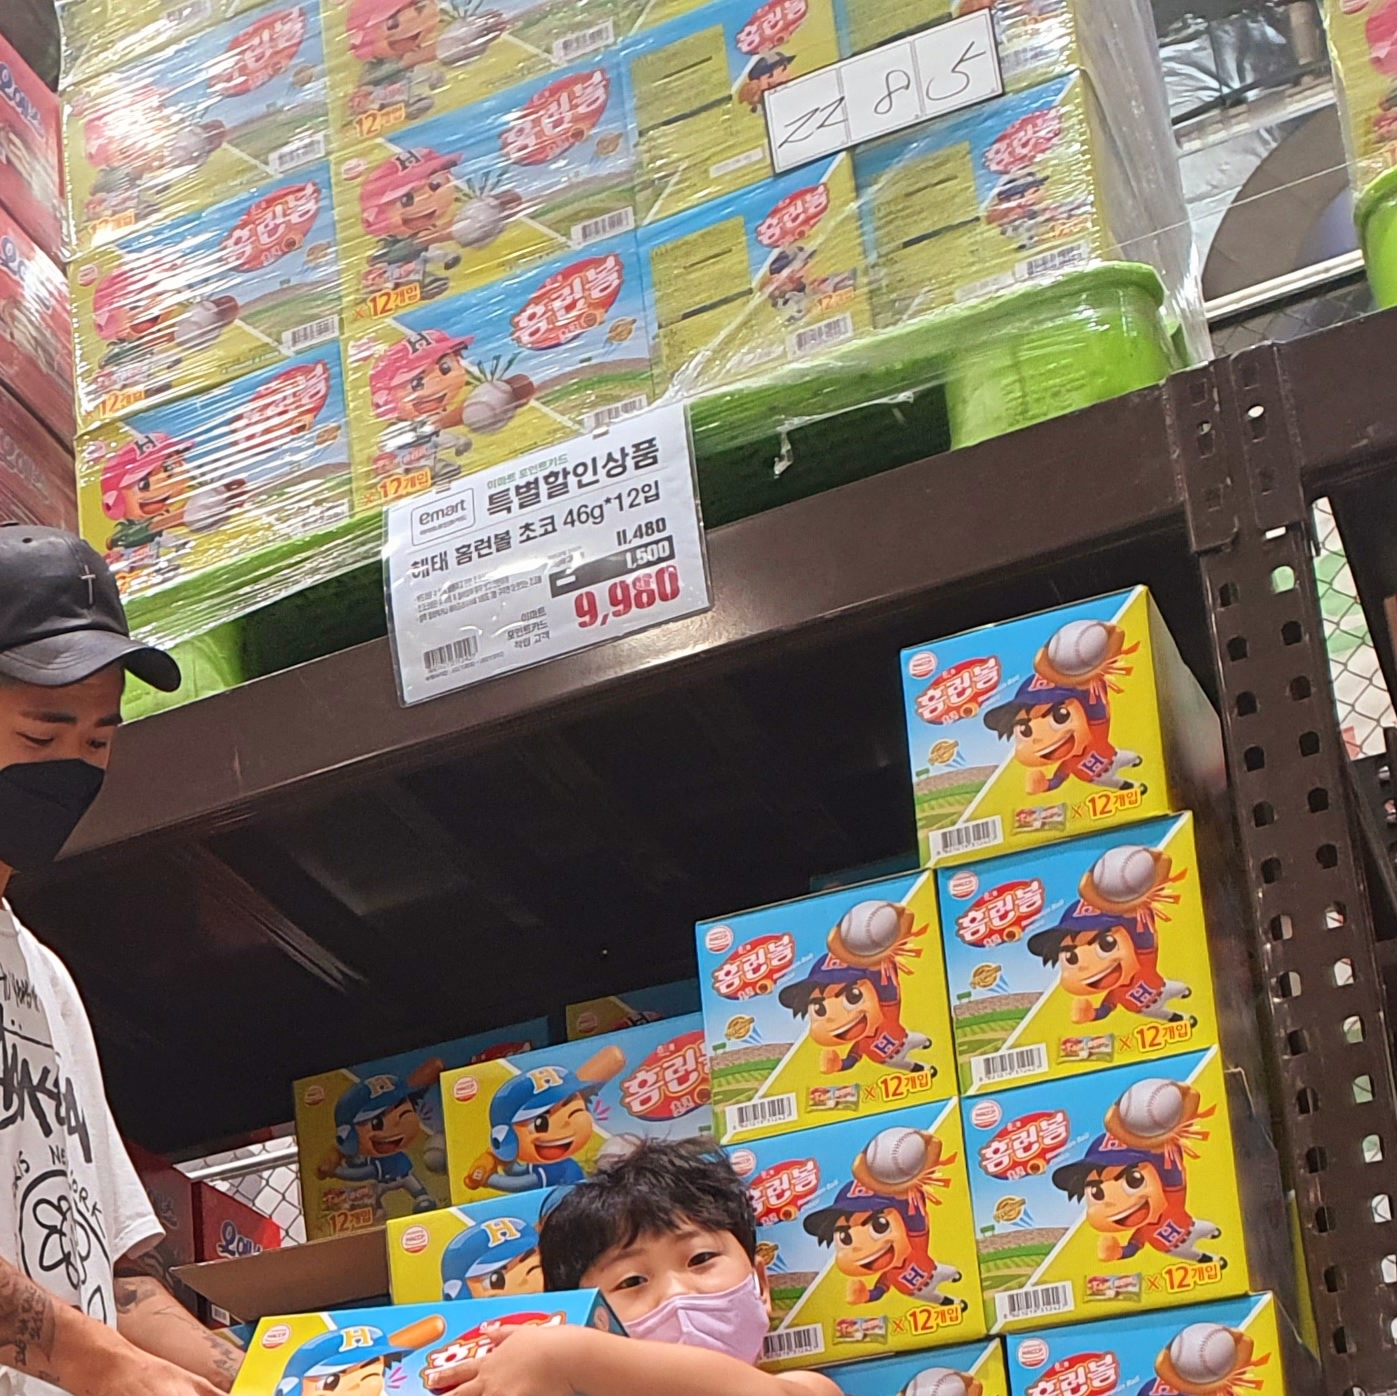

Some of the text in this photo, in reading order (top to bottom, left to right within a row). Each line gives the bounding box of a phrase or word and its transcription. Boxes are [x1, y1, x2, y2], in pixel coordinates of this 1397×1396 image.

[873, 69, 911, 115] 8
[925, 41, 986, 101] 5
[501, 68, 612, 158] 홈런볼
[221, 180, 321, 262] 홈런볼
[757, 184, 830, 246] 홈런볼
[369, 284, 421, 319] 12개입
[511, 254, 625, 343] 홈런볼
[486, 436, 660, 516] 특별할인상품
[418, 498, 467, 526] emart
[410, 551, 449, 580] 해태
[455, 529, 512, 566] 홈런볼
[518, 515, 558, 545] 초코
[573, 564, 681, 630] 9,980
[916, 656, 1001, 716] 홈런볼
[1087, 788, 1142, 817] 12개입
[955, 879, 1045, 944] 홈런볼
[711, 935, 796, 996] 홈런볼
[1133, 1021, 1191, 1051] 12개입
[879, 1071, 932, 1100] 12개입
[981, 1113, 1068, 1172] 홈런볼
[1164, 1262, 1221, 1290] 12개입
[908, 1306, 962, 1333] 12개입
